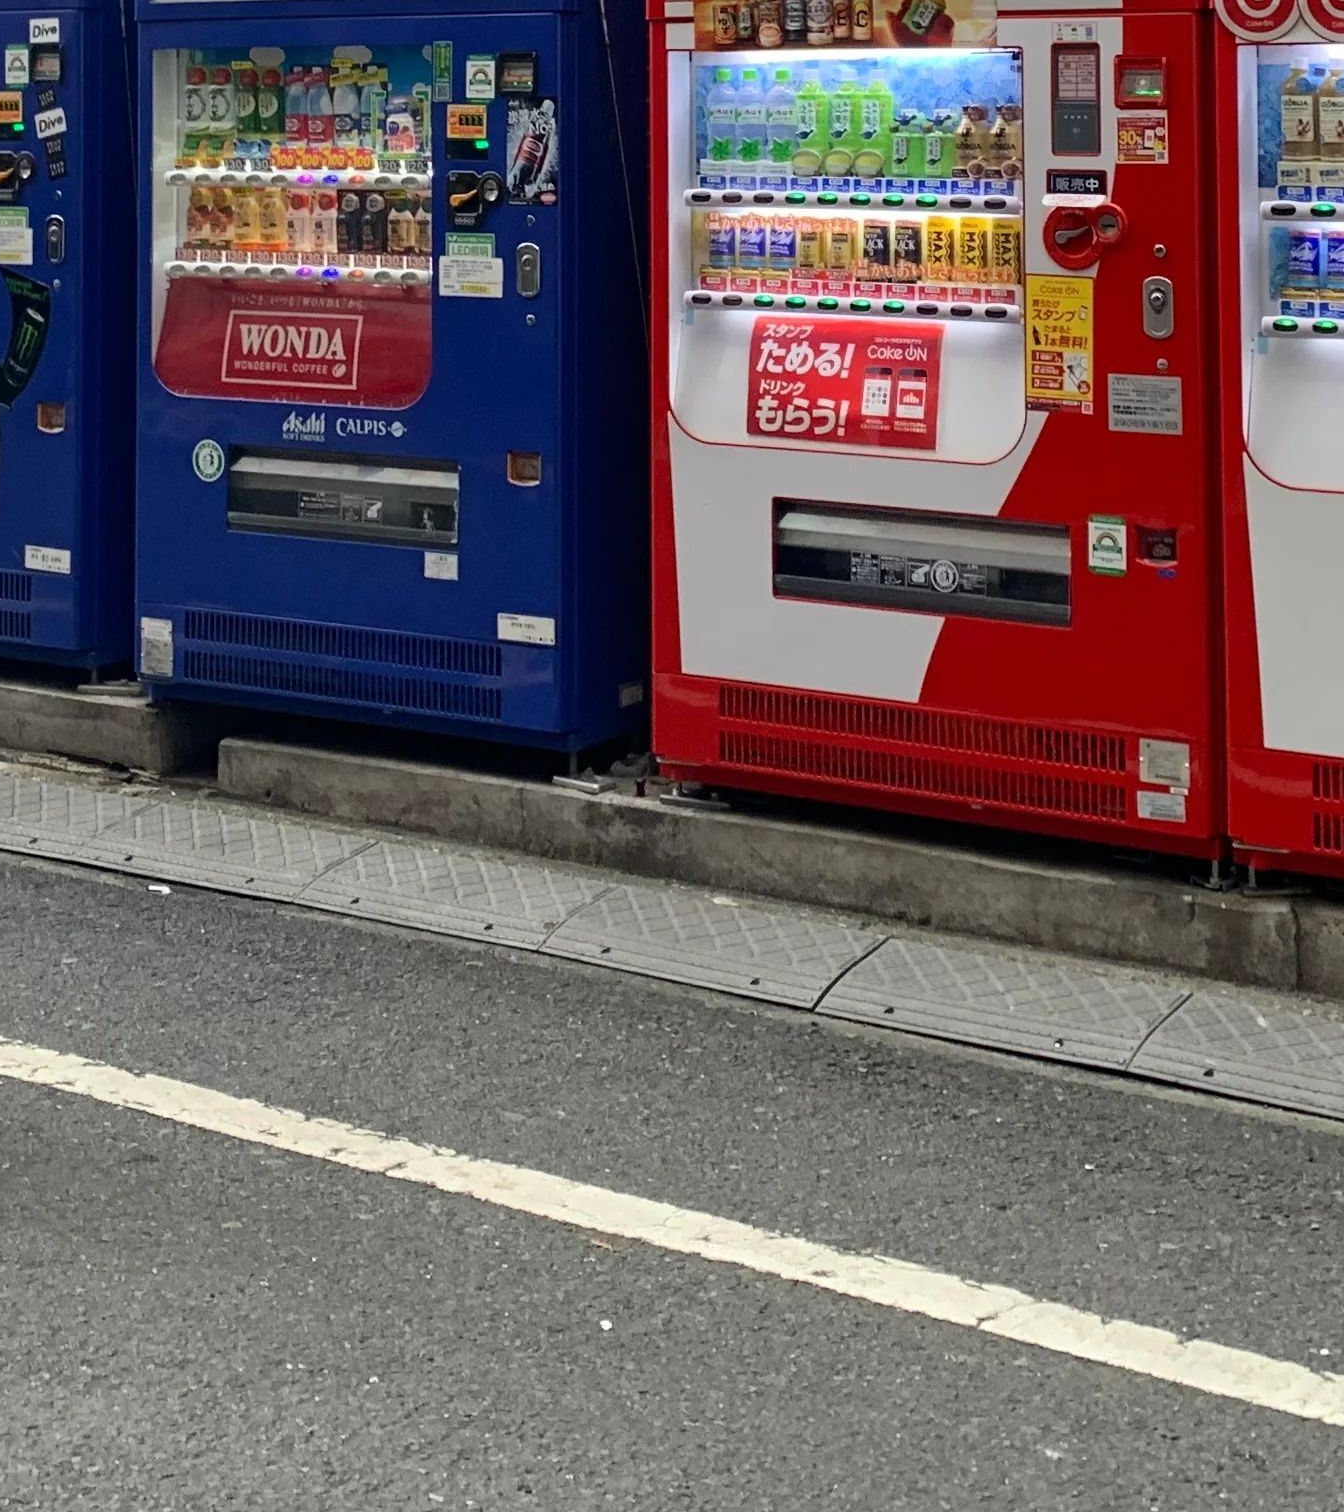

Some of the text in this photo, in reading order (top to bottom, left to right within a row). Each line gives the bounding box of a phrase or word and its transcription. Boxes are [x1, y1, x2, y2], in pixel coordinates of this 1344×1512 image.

[32, 24, 58, 38] Dive
[38, 115, 64, 134] Dive
[1055, 176, 1099, 192] 販売中
[1032, 298, 1060, 309] 買うたび
[1032, 309, 1077, 322] スタンプ
[762, 324, 815, 338] スタンプ
[1044, 324, 1072, 335] たまると
[239, 323, 347, 361] WONDA
[1043, 334, 1088, 350] 1本無料!
[756, 339, 856, 379] ためる!
[867, 344, 928, 362] Coke ON
[234, 359, 329, 377] WONDERFUL COFFEE
[759, 379, 806, 396] ドリンク
[282, 410, 326, 434] Asahi
[756, 395, 851, 437] もらう!
[336, 417, 387, 437] CALPIS
